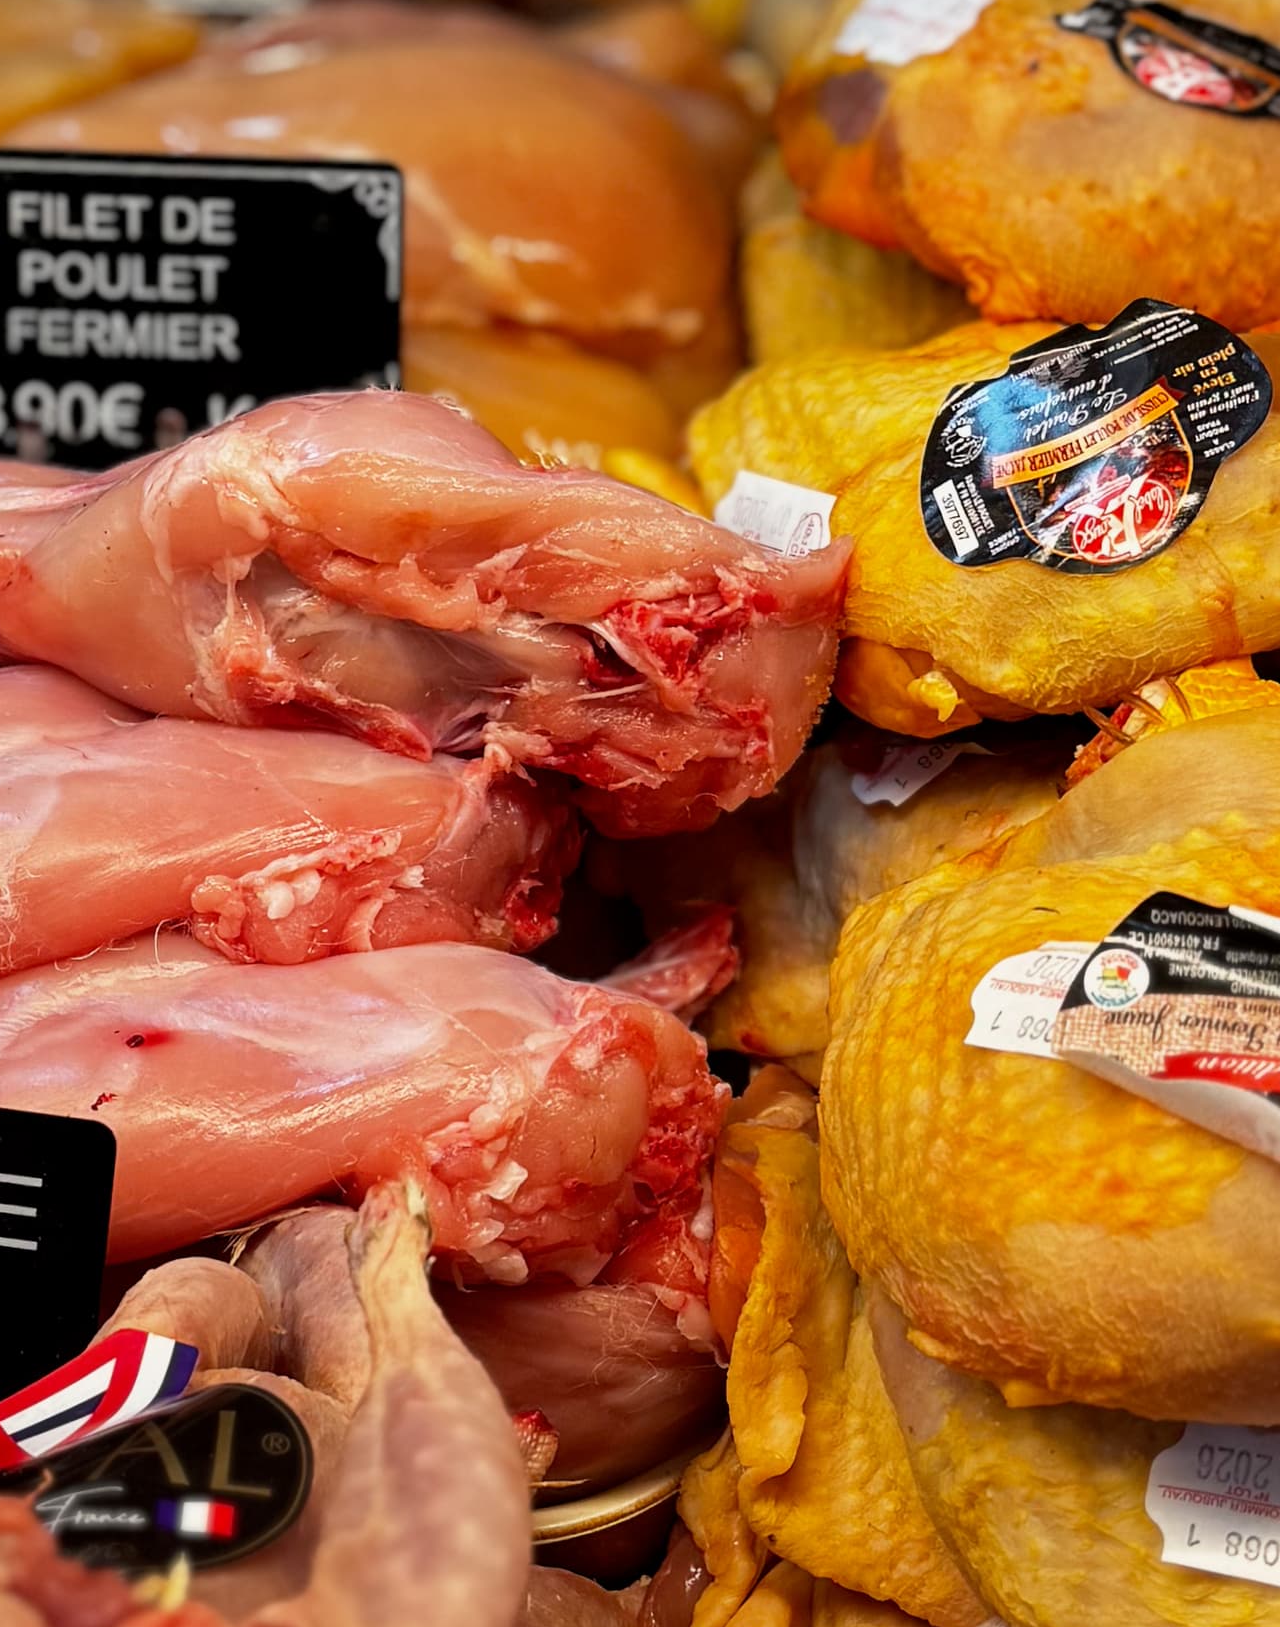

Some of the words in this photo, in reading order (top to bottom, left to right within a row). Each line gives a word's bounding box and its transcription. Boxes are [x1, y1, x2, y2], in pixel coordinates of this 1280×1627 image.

[8, 190, 152, 241] FILET
[162, 197, 236, 245] DE
[18, 250, 228, 302] POULET
[6, 308, 240, 362] FERMIER
[1197, 342, 1236, 367] plein
[1170, 362, 1195, 380] air
[1199, 365, 1218, 378] en
[1119, 410, 1136, 428] DE
[1133, 391, 1167, 420] CUISSE
[1081, 417, 1122, 447] POULET
[1026, 437, 1083, 472] FERMIER
[1101, 1007, 1171, 1040] Jaune
[1176, 1011, 1266, 1050] Fermier
[1224, 1484, 1250, 1497] LOT
[35, 1484, 149, 1536] France
[1185, 1522, 1202, 1547] 1
